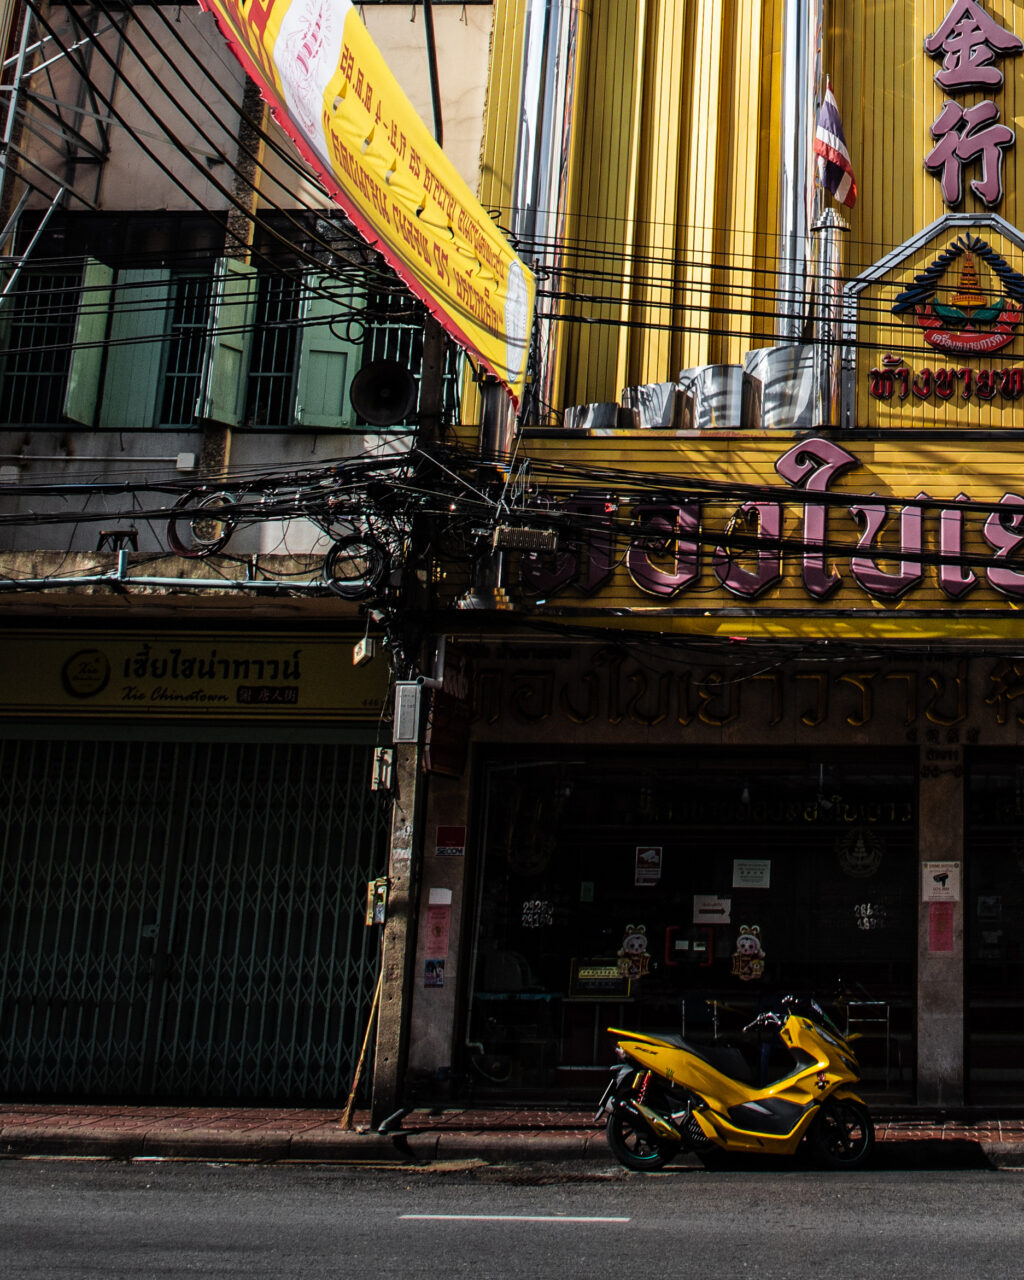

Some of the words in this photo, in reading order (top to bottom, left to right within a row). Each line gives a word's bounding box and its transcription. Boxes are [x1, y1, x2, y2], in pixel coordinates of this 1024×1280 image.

[121, 685, 146, 702] Xie
[150, 685, 230, 702] Chinatown
[436, 847, 464, 855] SECOM
